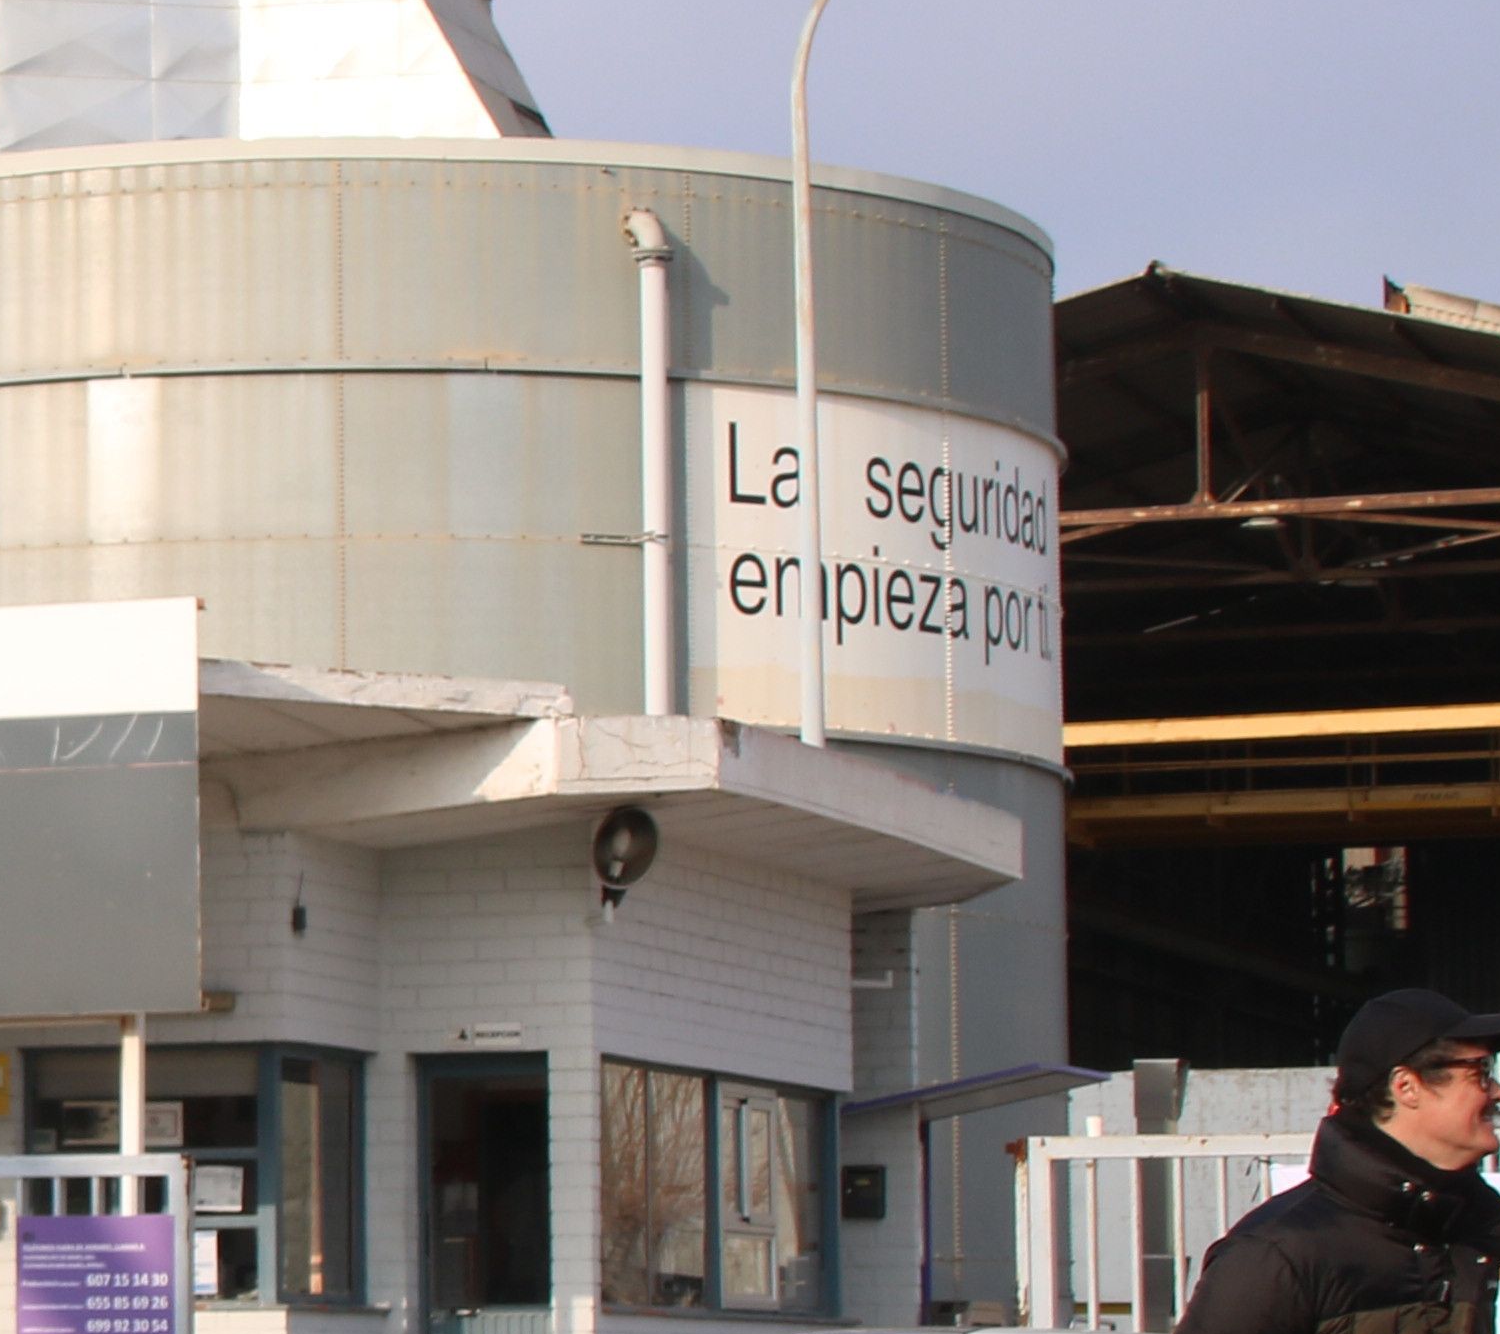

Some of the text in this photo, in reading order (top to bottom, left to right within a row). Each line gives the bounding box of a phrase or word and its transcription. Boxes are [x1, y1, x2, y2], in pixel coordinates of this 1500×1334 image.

[729, 421, 1047, 556] La seguridad
[984, 584, 1032, 666] por
